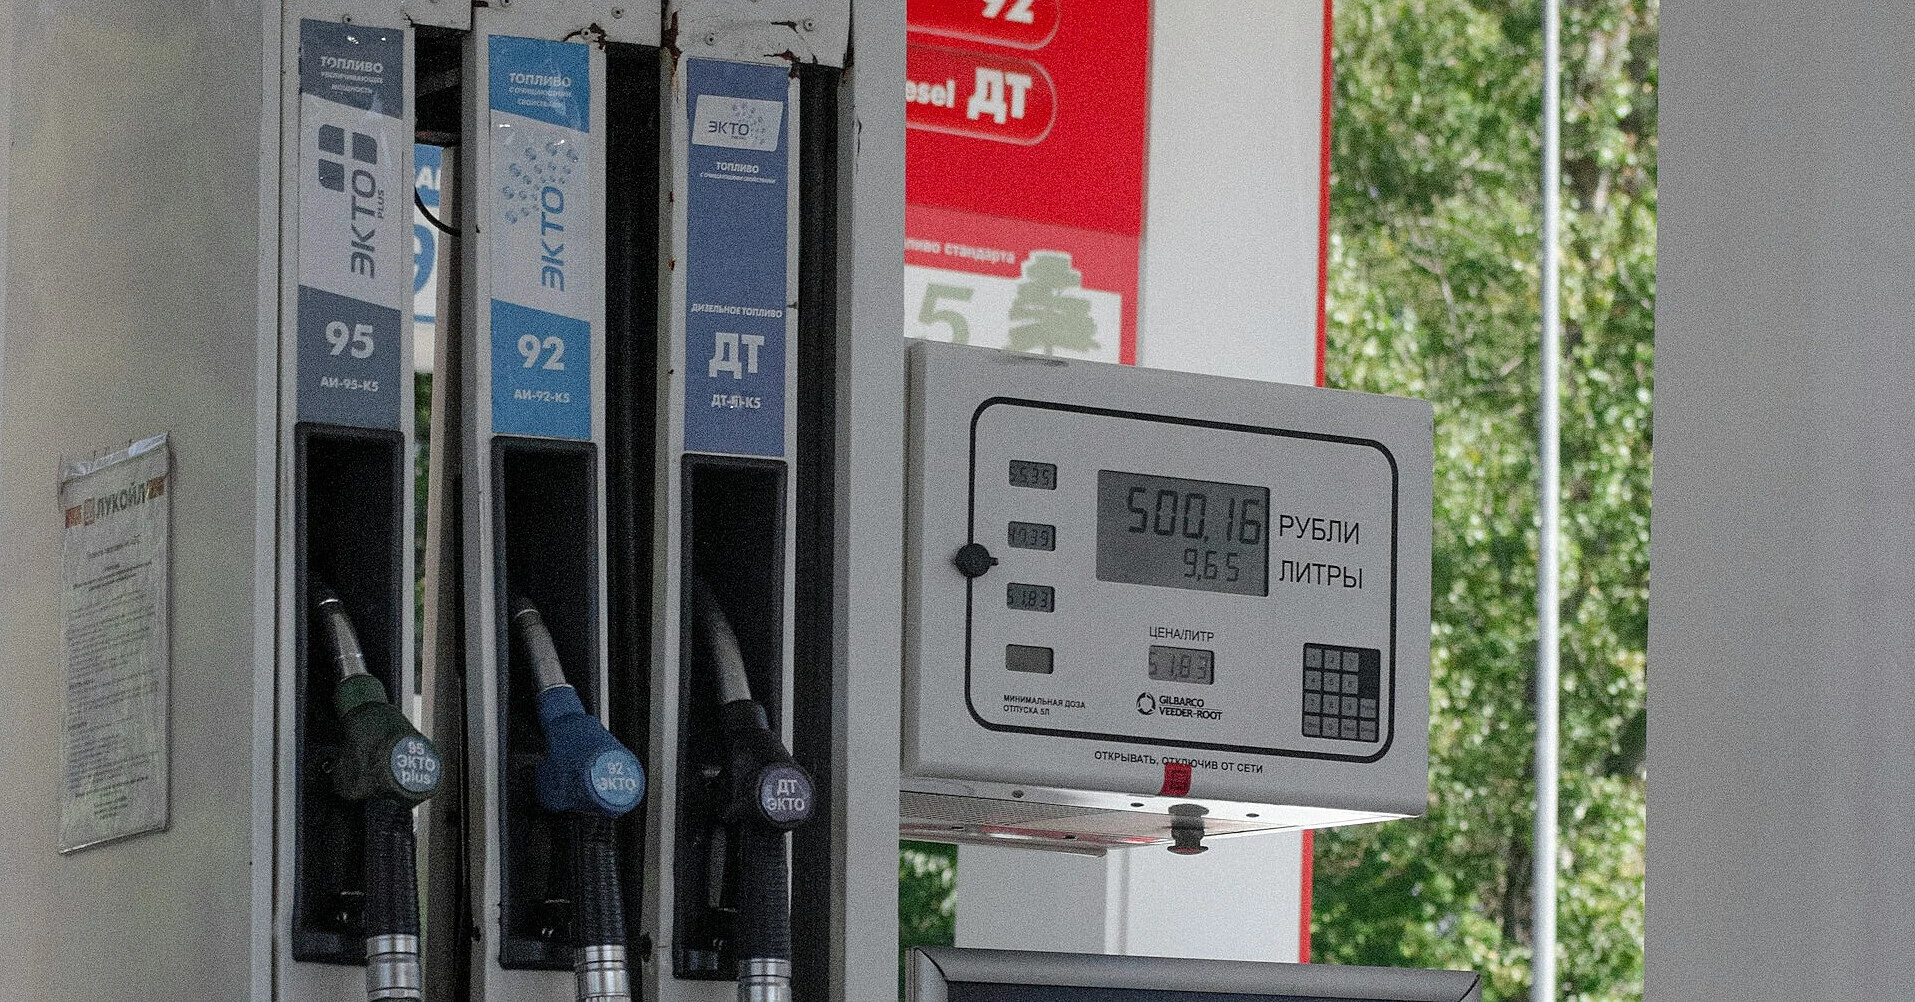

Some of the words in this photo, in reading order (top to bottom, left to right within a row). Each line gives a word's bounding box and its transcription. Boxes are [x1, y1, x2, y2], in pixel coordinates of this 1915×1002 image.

[320, 56, 383, 73] ТОПЛИВО
[510, 73, 571, 87] ТОПЛИВО
[906, 78, 955, 109] esel
[967, 67, 1032, 124] ДТ
[708, 121, 749, 136] ЭКТО
[716, 161, 759, 173] ТОПЛИВО
[350, 169, 376, 279] ЭКТО
[541, 186, 564, 292] ЭКТО
[944, 243, 1015, 264] стандарта
[691, 303, 740, 315] ДИЗЕЛЬНОЕ
[742, 307, 783, 318] ТОПЛИВО
[918, 283, 974, 345] 5
[325, 321, 374, 358] 95
[517, 334, 565, 370] 92
[708, 332, 764, 379] ДТ
[320, 376, 379, 392] АИ-95-К5
[514, 389, 570, 403] АИ-92-К5
[96, 482, 145, 518] ЛУКОЙЛ
[1127, 486, 1261, 545] 500,16
[1279, 514, 1360, 545] РУБЛИ
[1183, 548, 1240, 582] 9,65
[1279, 560, 1363, 589] ЛИТРЫ
[1149, 626, 1215, 642] ЦЕНА/ЛИТР
[1003, 694, 1063, 707] МИНИМАЛЬНАЯ
[1065, 700, 1086, 709] ДОЗА
[1159, 695, 1205, 708] GILBARCO
[1003, 705, 1038, 714] ОТПУСКА
[1040, 708, 1050, 716] 5Л
[1159, 707, 1223, 720] VEEDER-ROOT
[397, 754, 436, 772] ЭКТО
[1094, 751, 1159, 766] ОТКРЫВАТЬ,
[1221, 762, 1234, 771] ОТ
[1237, 763, 1263, 774] СЕТИ
[402, 769, 431, 785] plus
[600, 777, 636, 791] ЭКТО
[777, 779, 797, 796] ДТ
[767, 797, 805, 811] ЭКТО
